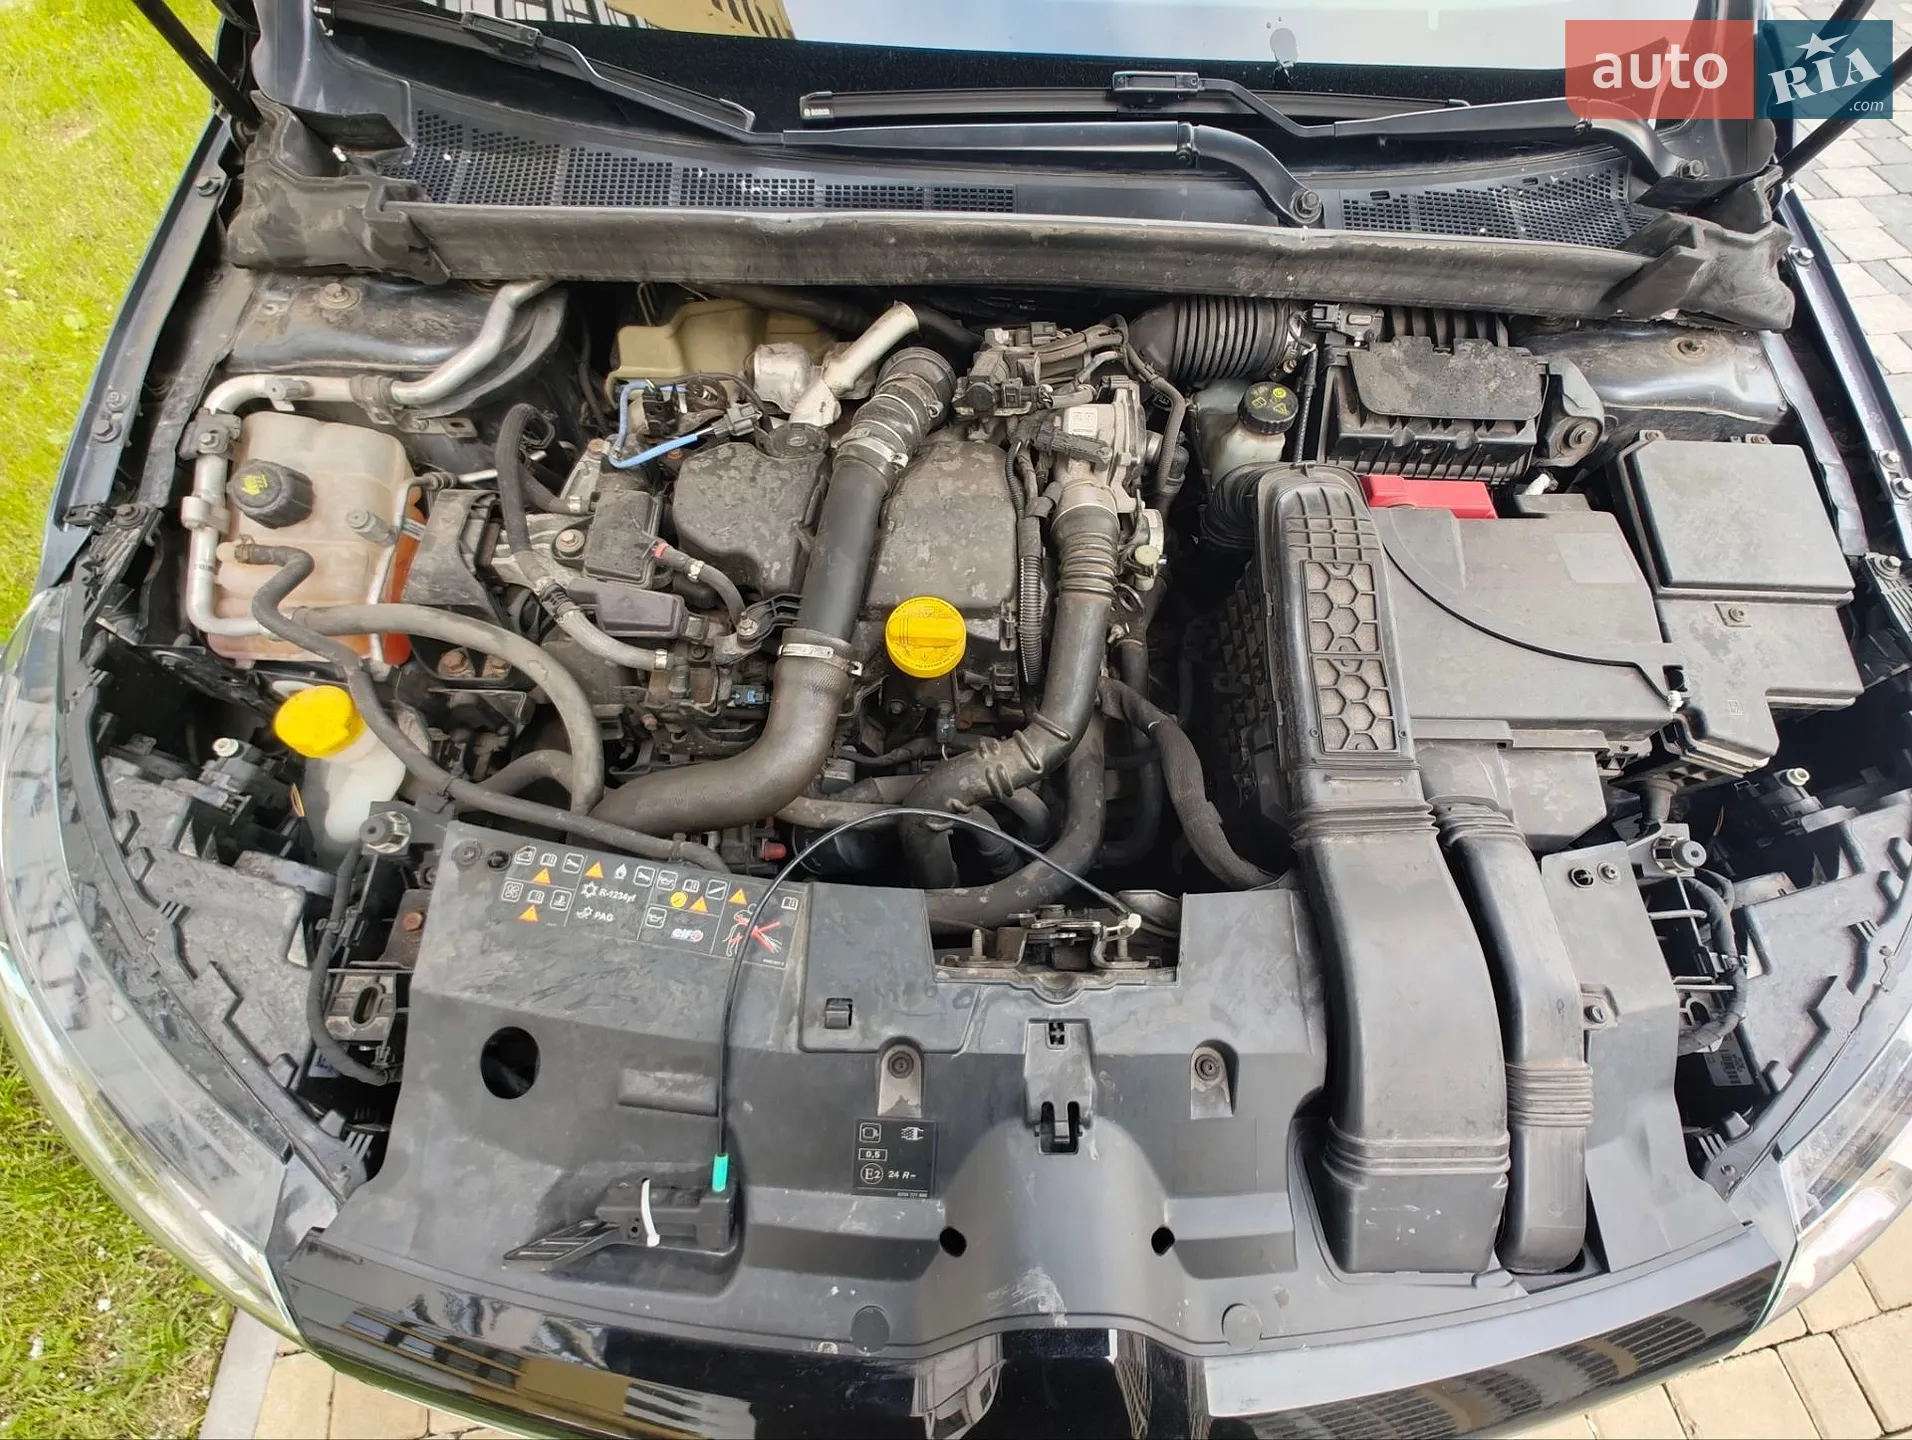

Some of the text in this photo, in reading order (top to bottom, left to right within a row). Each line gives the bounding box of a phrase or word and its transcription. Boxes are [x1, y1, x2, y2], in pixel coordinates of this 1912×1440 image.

[599, 888, 637, 903] R-1234yf
[593, 911, 614, 922] PAG
[864, 1168, 881, 1180] E2
[887, 1170, 899, 1179] 24
